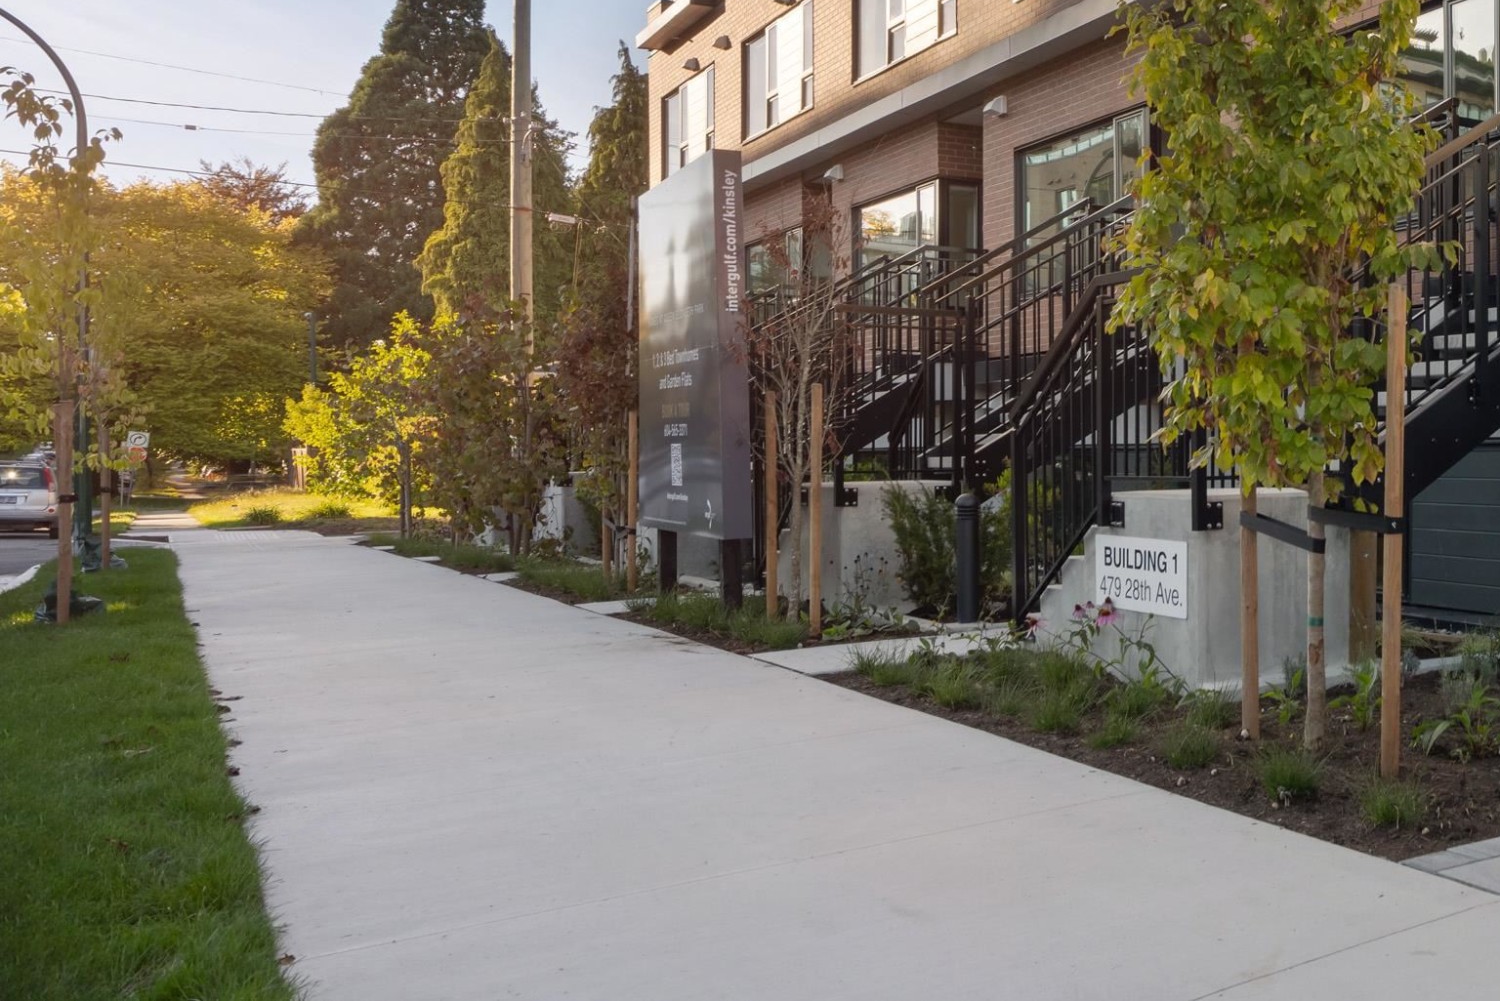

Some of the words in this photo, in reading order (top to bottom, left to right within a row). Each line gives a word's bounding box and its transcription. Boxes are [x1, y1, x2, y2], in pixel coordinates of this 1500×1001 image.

[722, 169, 741, 312] intergulf.com/kinsley
[1104, 546, 1167, 573] BUILDING
[1172, 553, 1178, 574] 1
[1100, 575, 1121, 598] 479
[1125, 577, 1151, 601] 28th
[1155, 581, 1183, 606] Ave.
